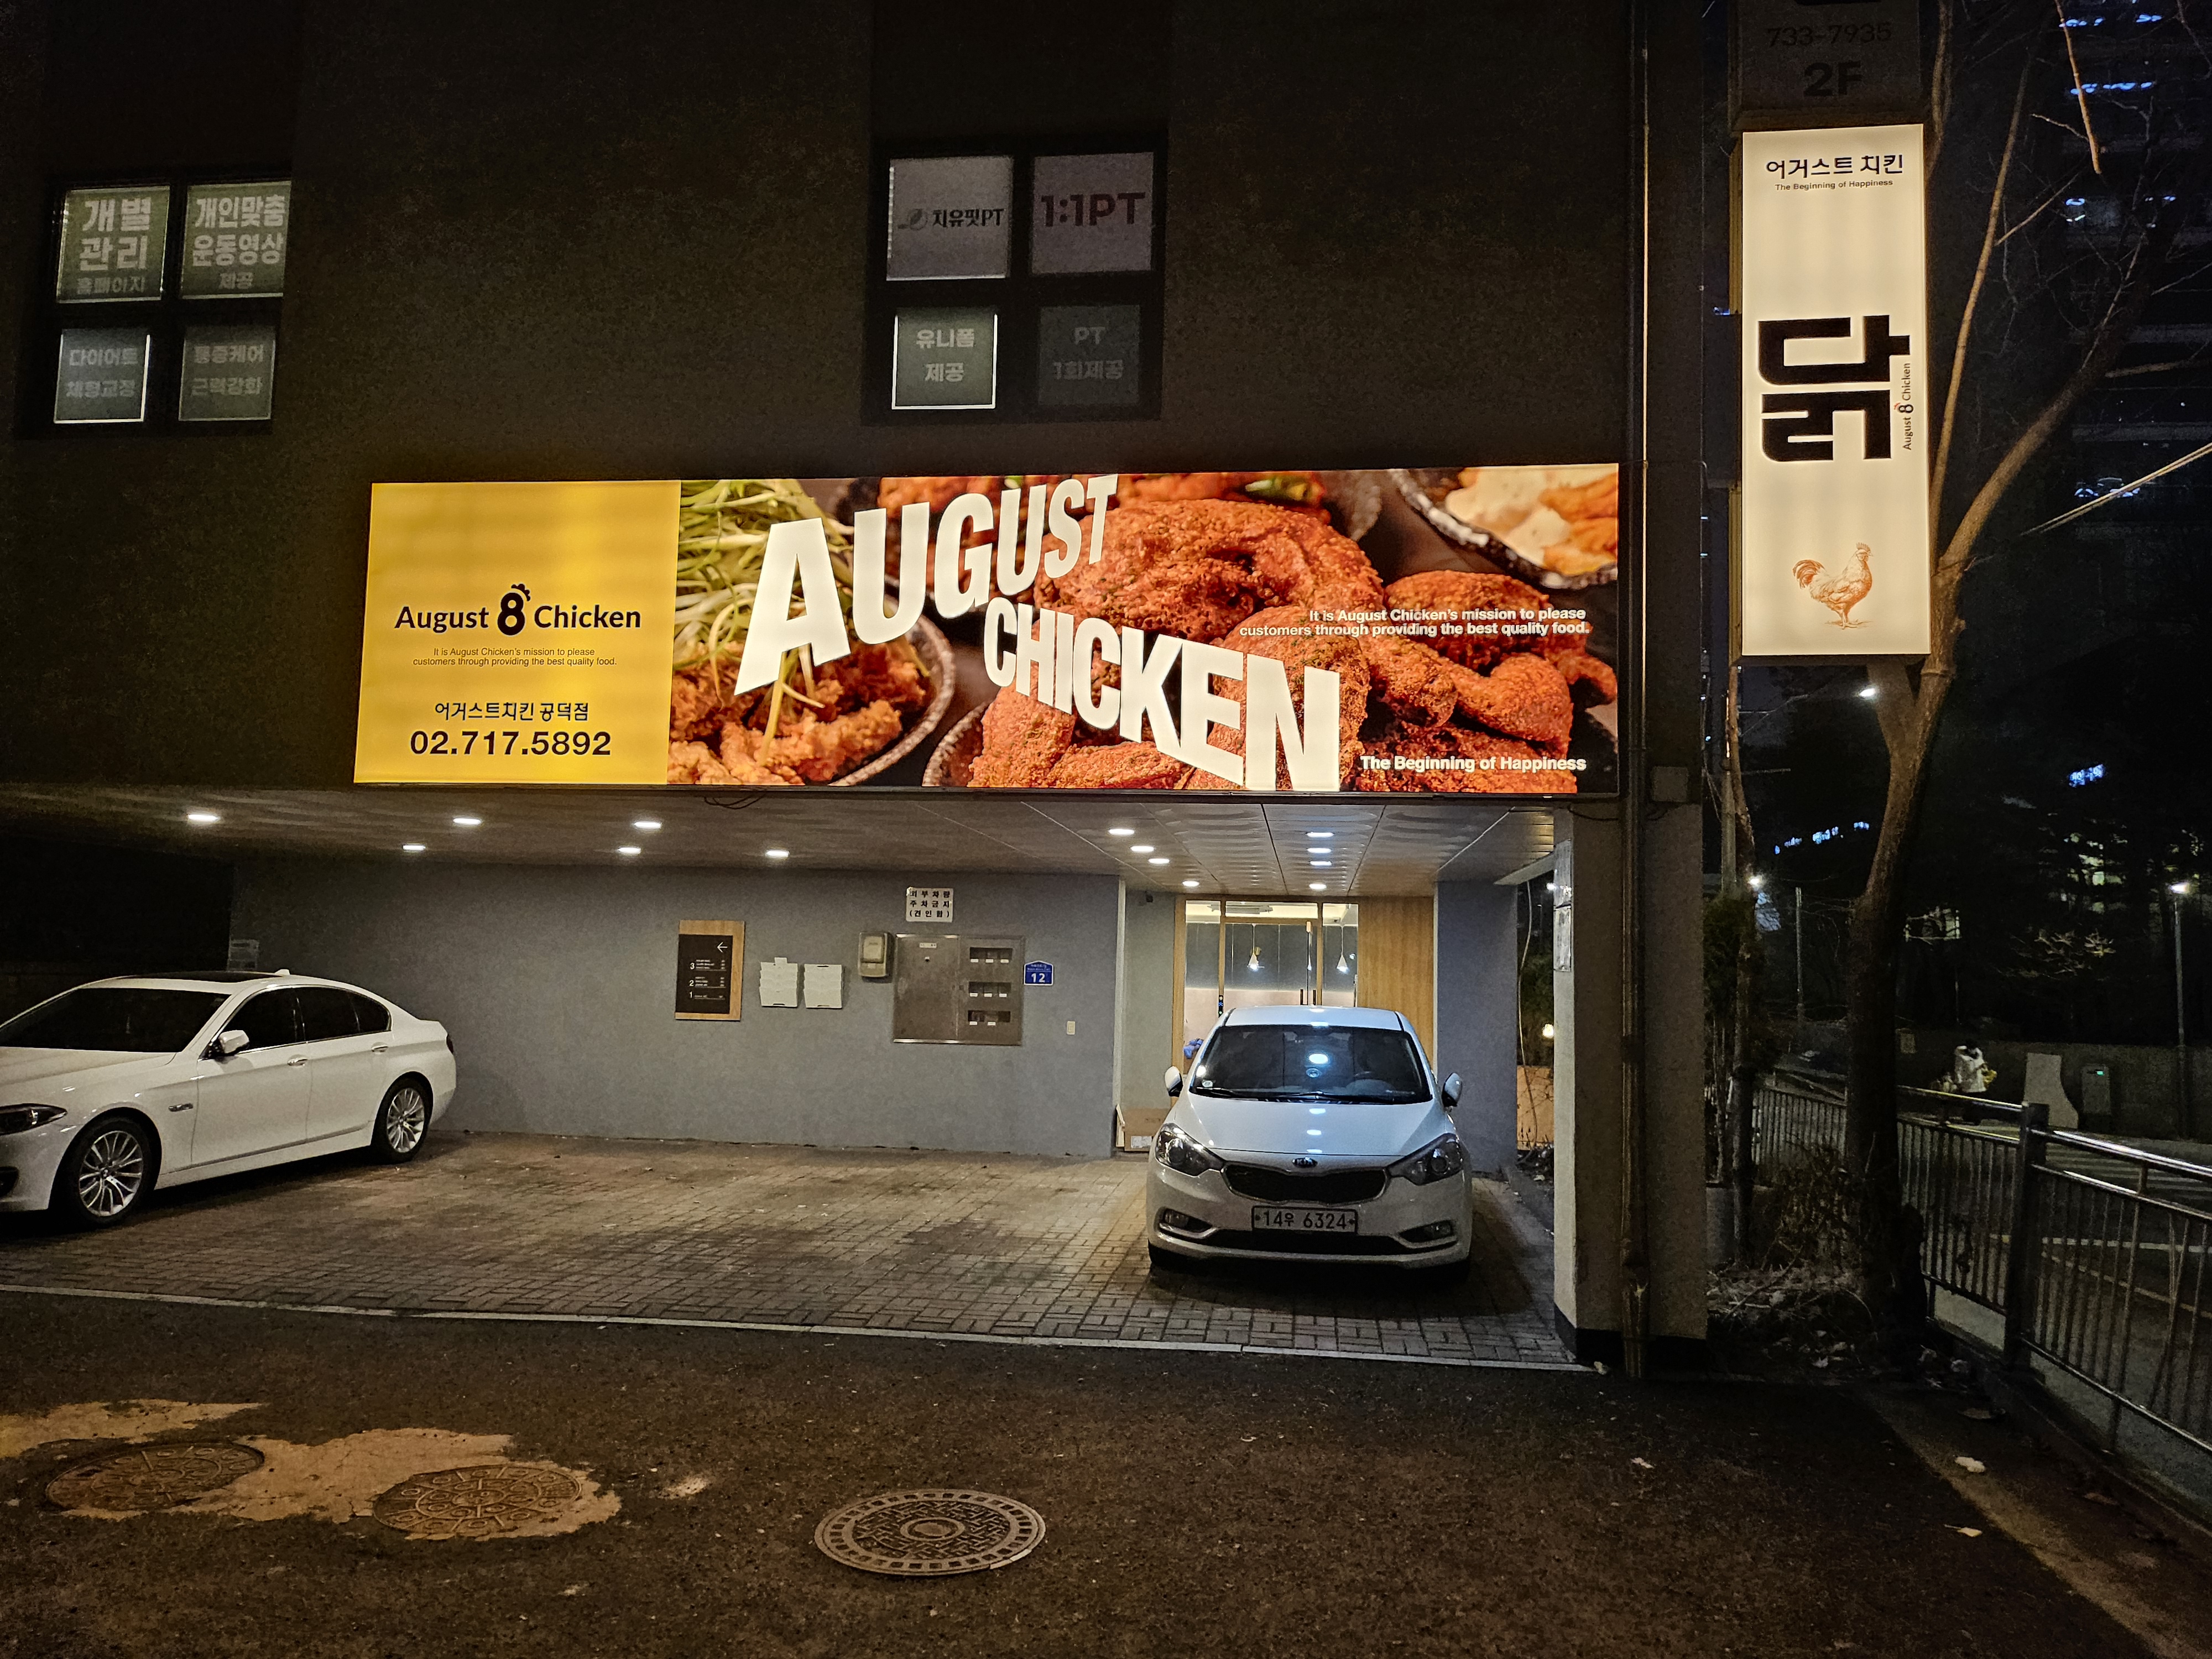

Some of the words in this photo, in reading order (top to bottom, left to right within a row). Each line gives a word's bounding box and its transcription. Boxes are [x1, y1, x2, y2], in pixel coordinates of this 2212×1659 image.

[1766, 22, 1892, 47] 733-7935
[1803, 60, 1863, 97] 2F
[1766, 157, 1853, 179] 어거스트
[1860, 154, 1903, 175] 치킨
[1793, 182, 1835, 191] Beginning
[1849, 179, 1893, 188] Happiness
[82, 197, 152, 232] 개별
[195, 194, 285, 228] 개인맞춤
[1041, 192, 1145, 227] 1:1PT
[79, 236, 148, 271] 관리
[193, 233, 284, 267] 운동영상
[76, 276, 145, 295] 홈페이지
[218, 272, 254, 290] 제공
[916, 328, 974, 349] 유니폼
[1074, 326, 1105, 345] PT
[69, 347, 138, 367] 다이어트
[924, 362, 964, 383] 제공
[1901, 363, 1911, 401] Chicken
[66, 379, 135, 398] 체형교정
[191, 377, 263, 396] 근력강화
[1759, 315, 1910, 462] 닭
[1902, 417, 1913, 451] August
[734, 474, 1118, 696] AUGUST
[394, 607, 489, 633] August
[498, 592, 525, 635] 8
[534, 605, 641, 628] Chicken
[1310, 611, 1320, 621] It
[1323, 611, 1334, 621] is
[1338, 610, 1387, 623] August
[1390, 608, 1458, 621] Chicken's
[1462, 608, 1517, 620] mission
[1520, 609, 1534, 620] to
[1538, 608, 1586, 622] please
[1240, 625, 1311, 636] customers
[1316, 624, 1368, 637] through
[1373, 623, 1437, 637] providing
[1441, 623, 1463, 634] the
[1467, 623, 1498, 634] best
[1502, 622, 1548, 637] quality
[1552, 622, 1589, 634] food.
[450, 648, 478, 657] August
[567, 648, 594, 657] please
[458, 658, 489, 666] through
[492, 658, 529, 667] providing
[567, 658, 594, 667] quality
[984, 597, 1340, 791] CHICKEN
[435, 702, 534, 721] 어거스트치킨
[540, 702, 589, 722] 공덕점
[410, 731, 611, 755] 02.717.5892
[1360, 756, 1390, 770] The
[1394, 756, 1476, 773] Beginning
[1480, 756, 1495, 770] of
[1500, 756, 1587, 772] Happiness
[1031, 973, 1045, 983] 12
[1264, 1211, 1294, 1227] 14우
[1303, 1212, 1346, 1229] 6324
